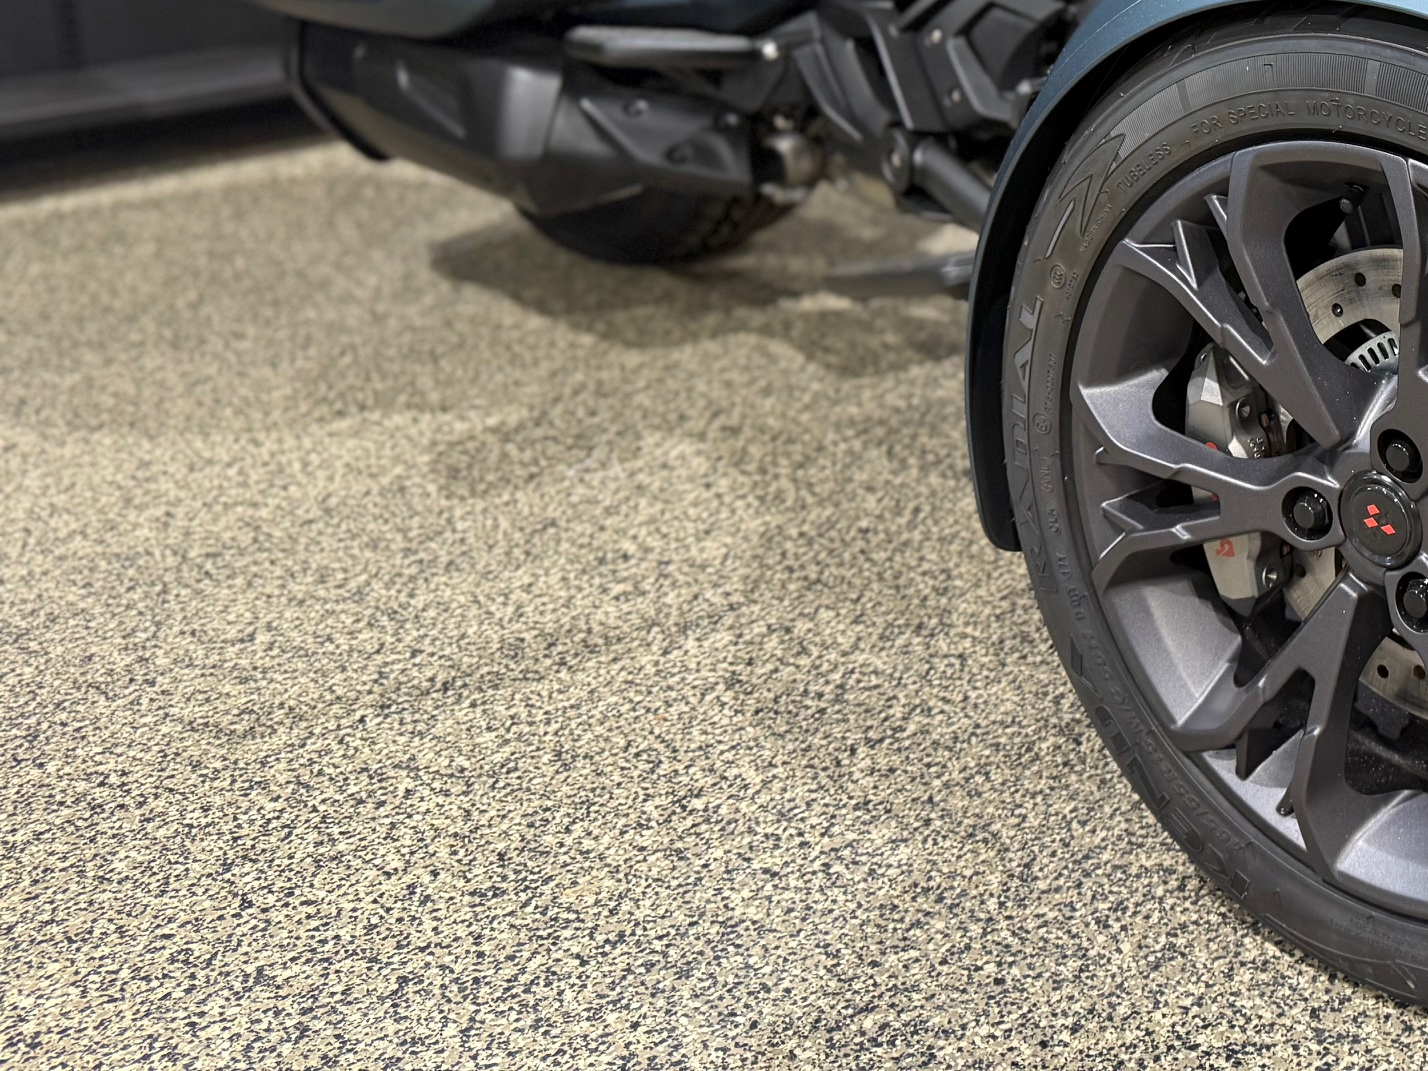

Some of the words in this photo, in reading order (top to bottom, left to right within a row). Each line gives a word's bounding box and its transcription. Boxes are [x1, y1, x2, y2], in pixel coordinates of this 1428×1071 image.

[1114, 139, 1174, 196] TUBELESS
[1188, 112, 1224, 139] FOR
[1224, 99, 1296, 126] SPECIAL
[1304, 98, 1427, 142] MOTORCYCLE
[1011, 294, 1059, 593] RADIAL
[1070, 634, 1251, 898] KENDA
